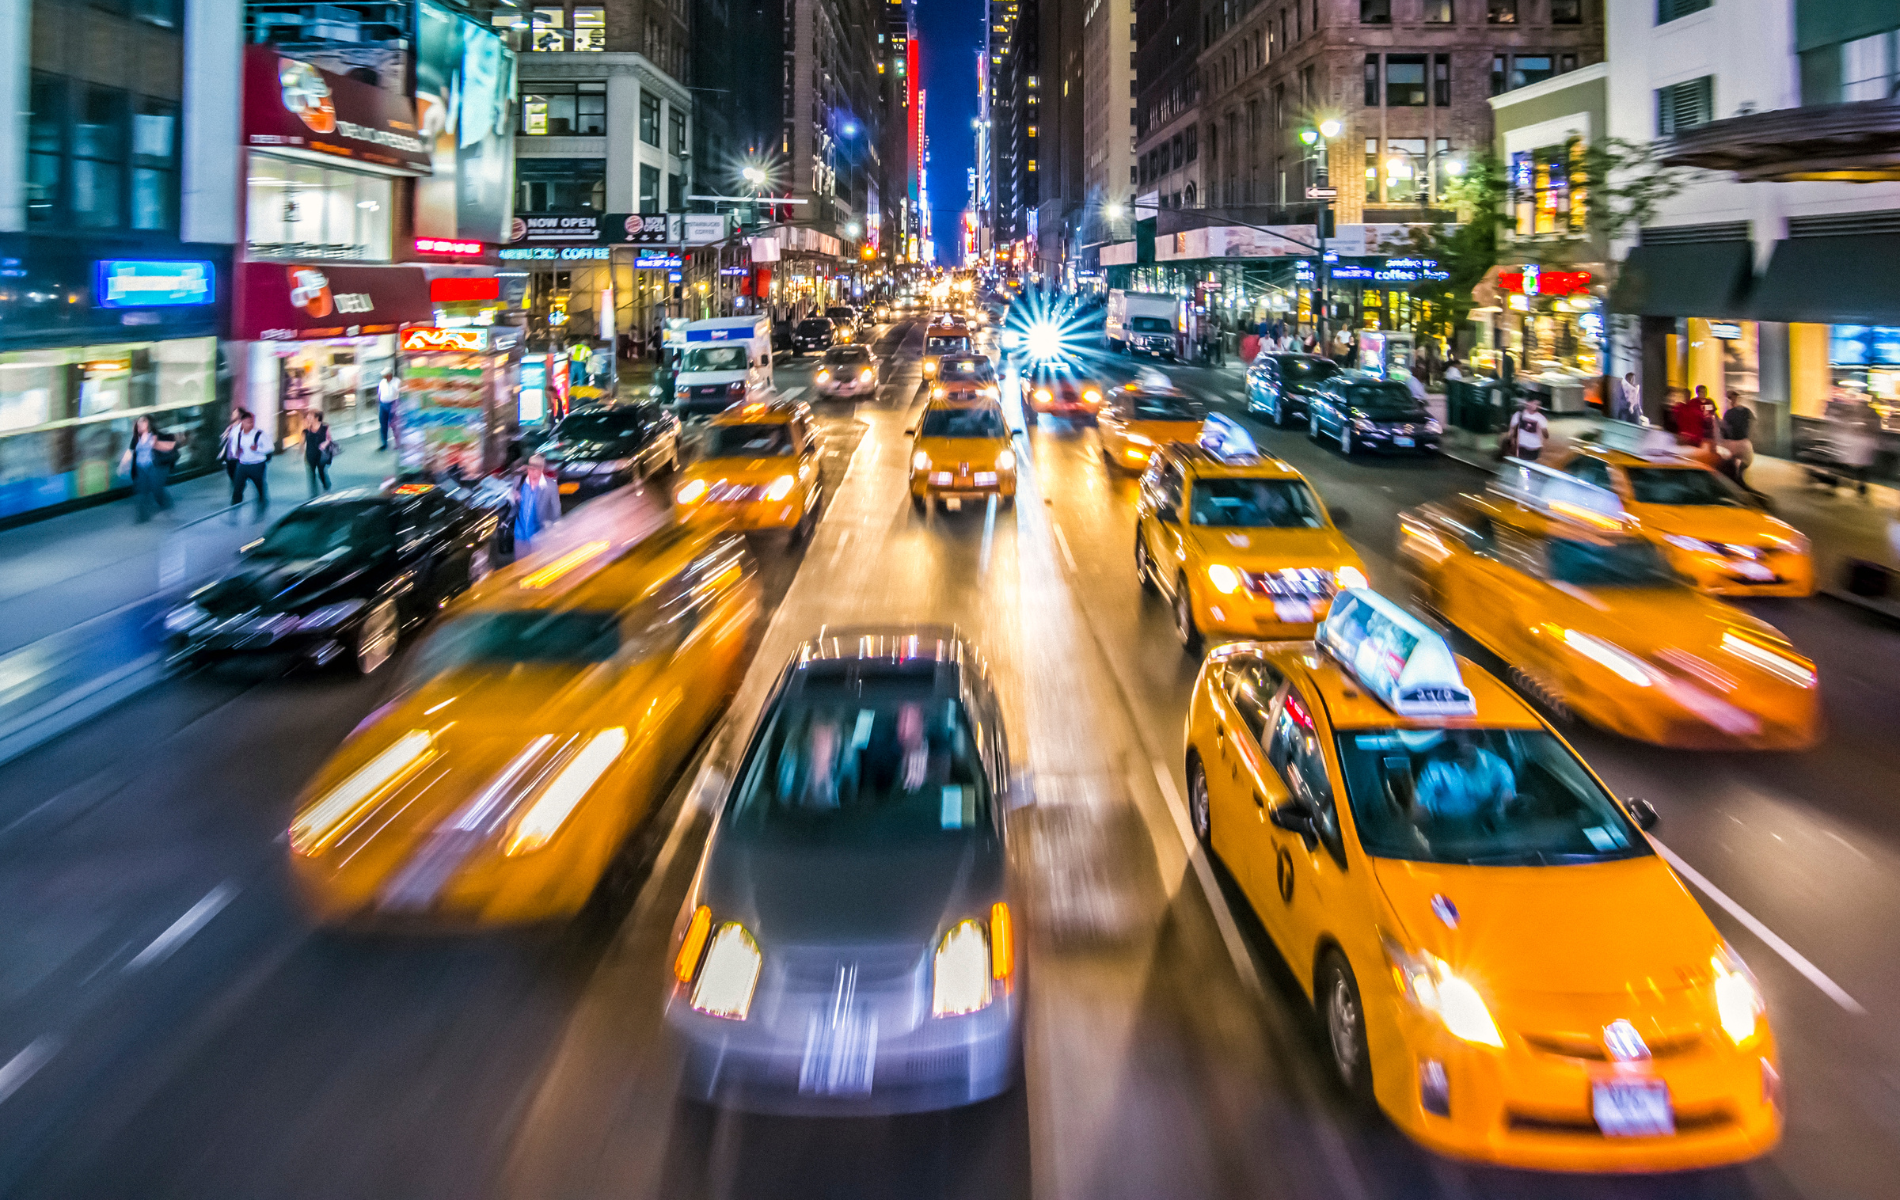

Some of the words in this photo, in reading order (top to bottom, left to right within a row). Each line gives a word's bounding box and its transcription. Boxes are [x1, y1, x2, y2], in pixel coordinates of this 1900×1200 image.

[527, 217, 559, 228] NOW
[560, 217, 598, 228] OPEN
[644, 216, 666, 225] NOW
[643, 223, 666, 233] OPEN
[560, 248, 610, 260] COFFEE
[1374, 268, 1418, 281] coffee
